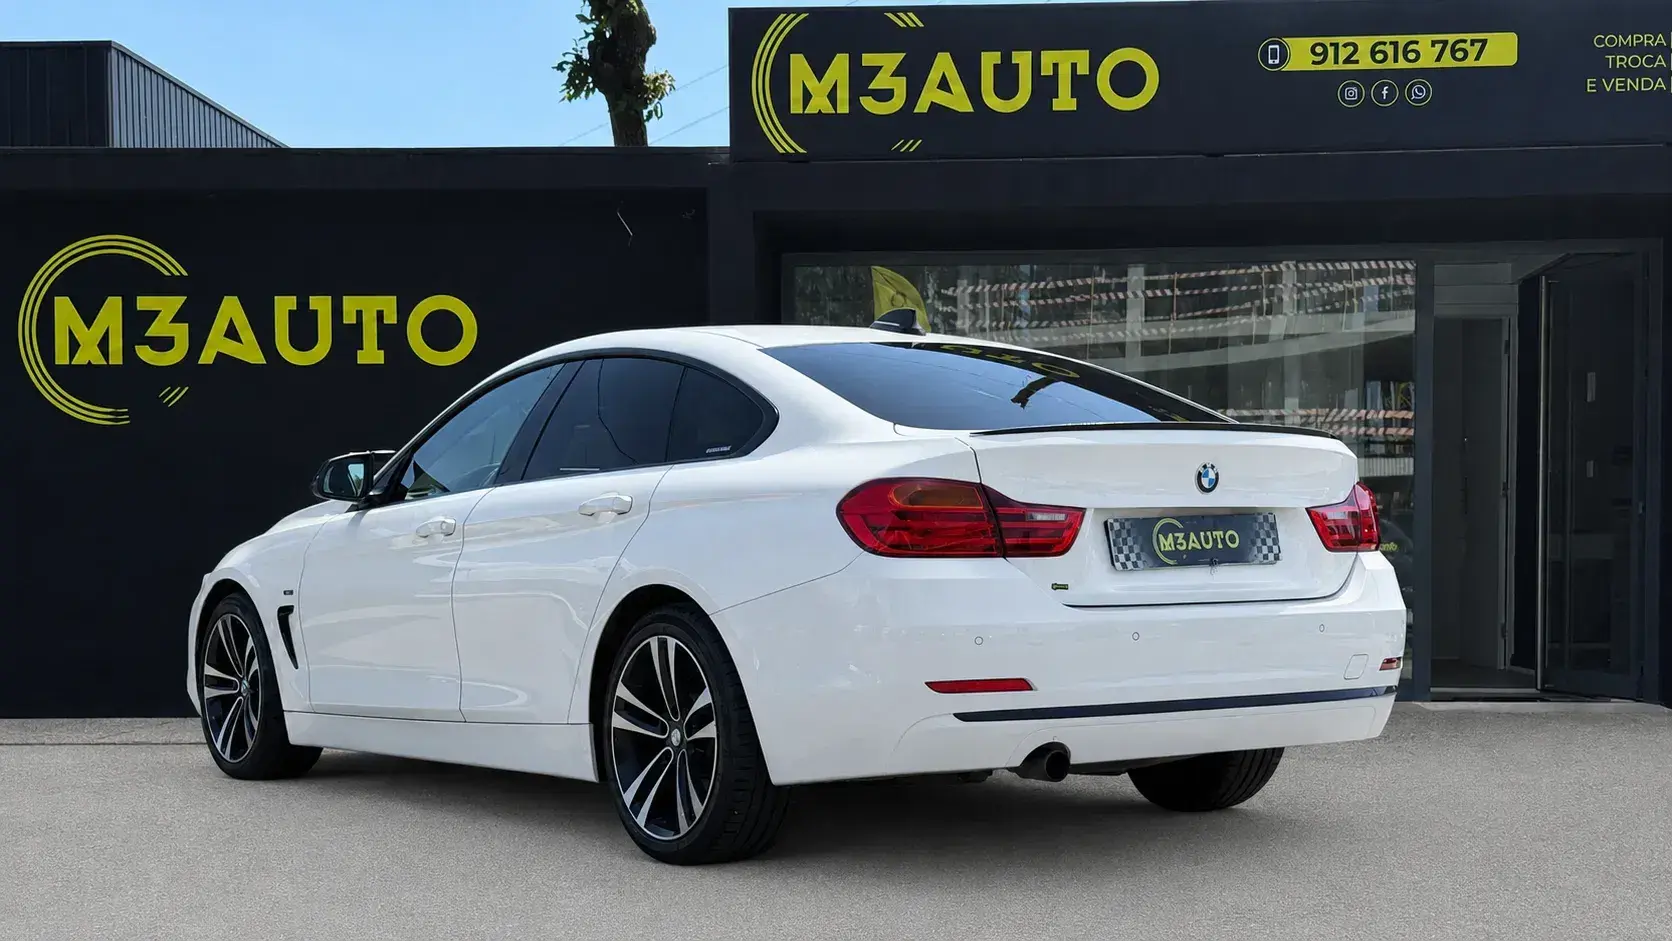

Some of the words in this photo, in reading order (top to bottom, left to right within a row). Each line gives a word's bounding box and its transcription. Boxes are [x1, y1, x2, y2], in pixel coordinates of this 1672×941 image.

[1310, 40, 1360, 66] 912
[1369, 39, 1421, 65] 616
[1430, 37, 1489, 63] 767
[1593, 33, 1667, 48] COMPRA
[1604, 54, 1667, 69] TROCA
[789, 47, 1160, 116] M3AUTO
[1586, 78, 1597, 93] E
[1601, 77, 1667, 92] VENDA
[53, 294, 479, 367] M3AUTO
[1158, 529, 1240, 552] M3AUTO
